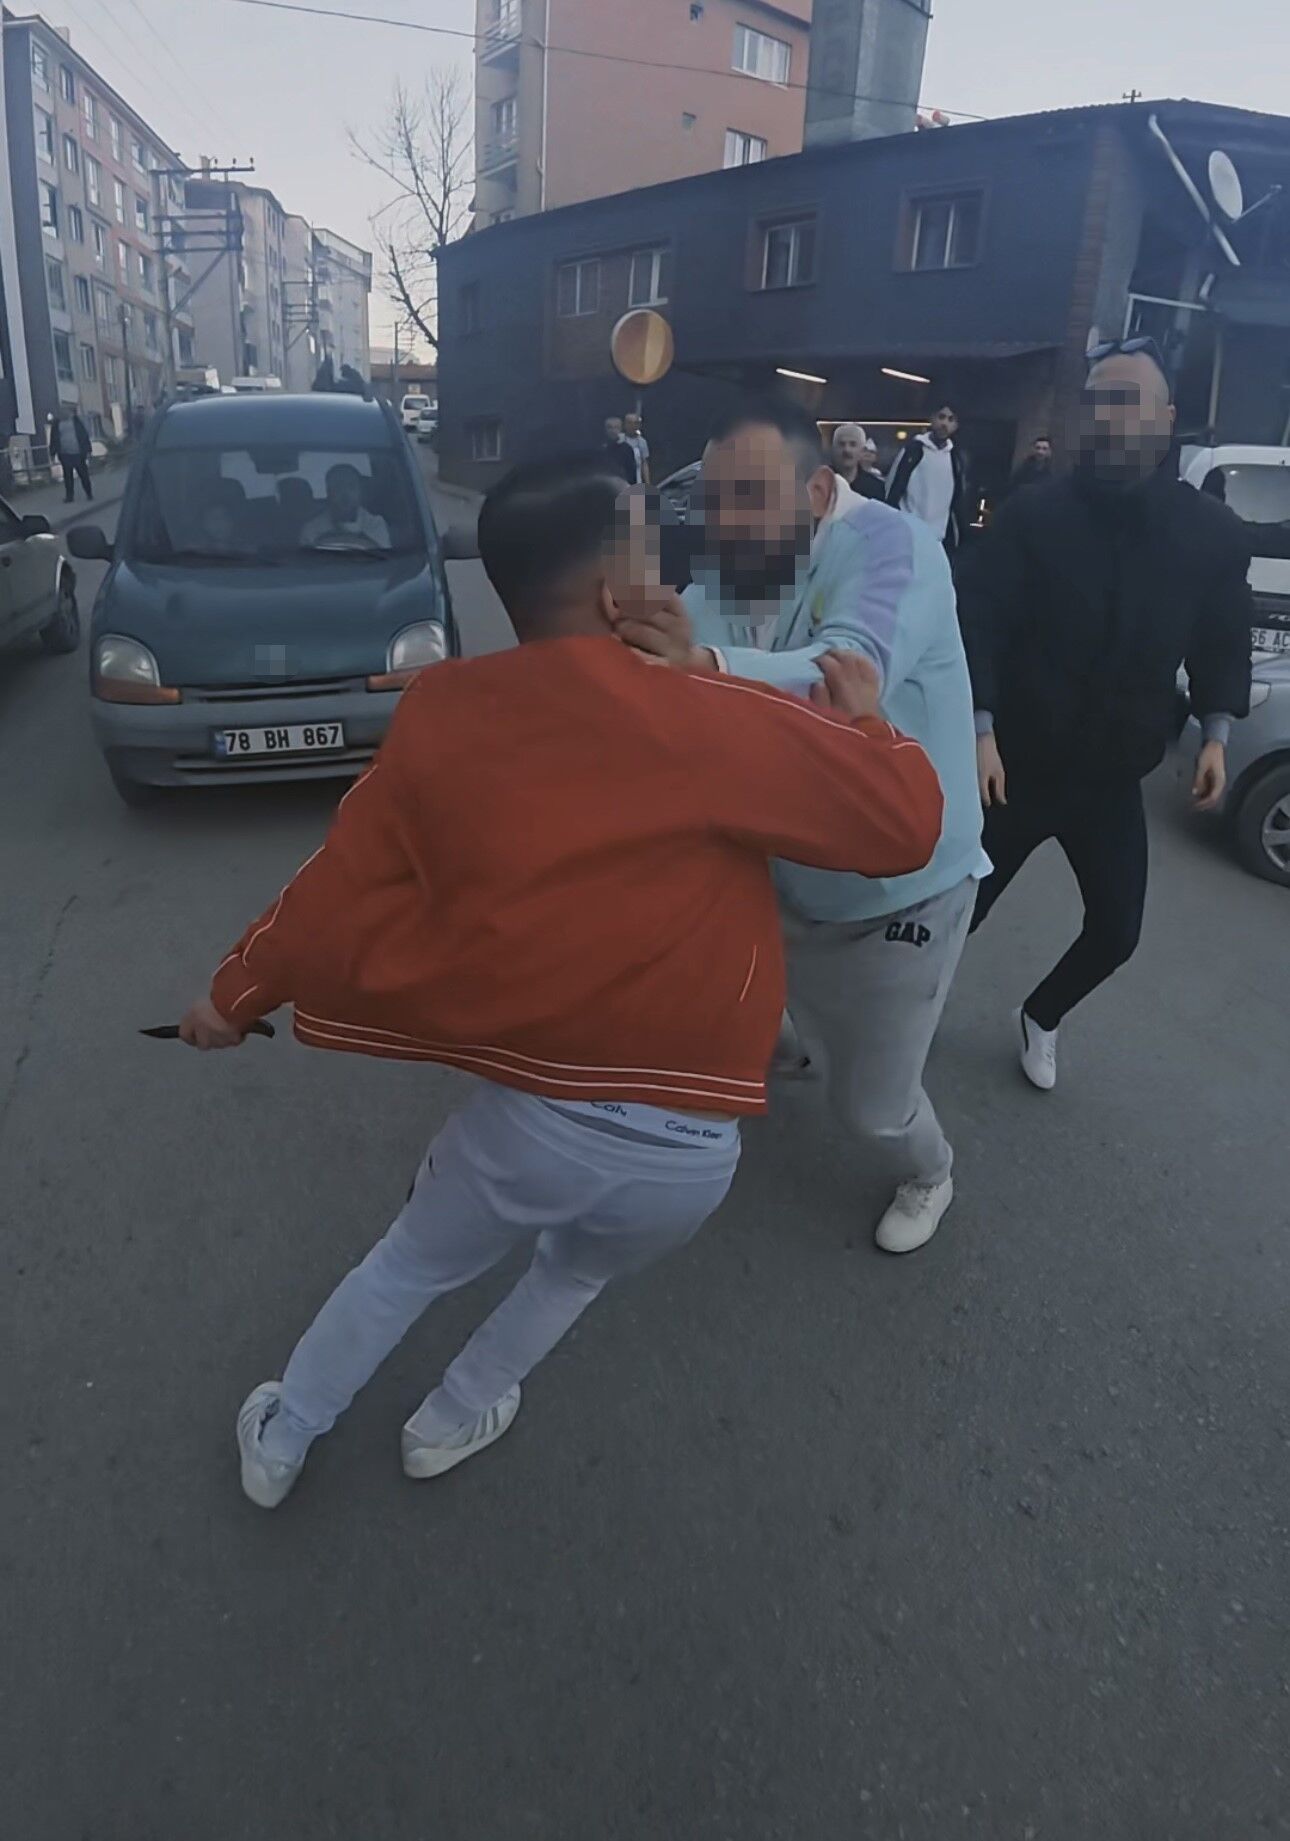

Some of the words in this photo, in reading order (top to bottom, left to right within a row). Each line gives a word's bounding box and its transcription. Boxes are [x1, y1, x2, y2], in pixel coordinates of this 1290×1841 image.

[225, 732, 251, 752] 78
[264, 729, 290, 749] BH
[303, 726, 339, 746] 867
[885, 921, 931, 948] GAP
